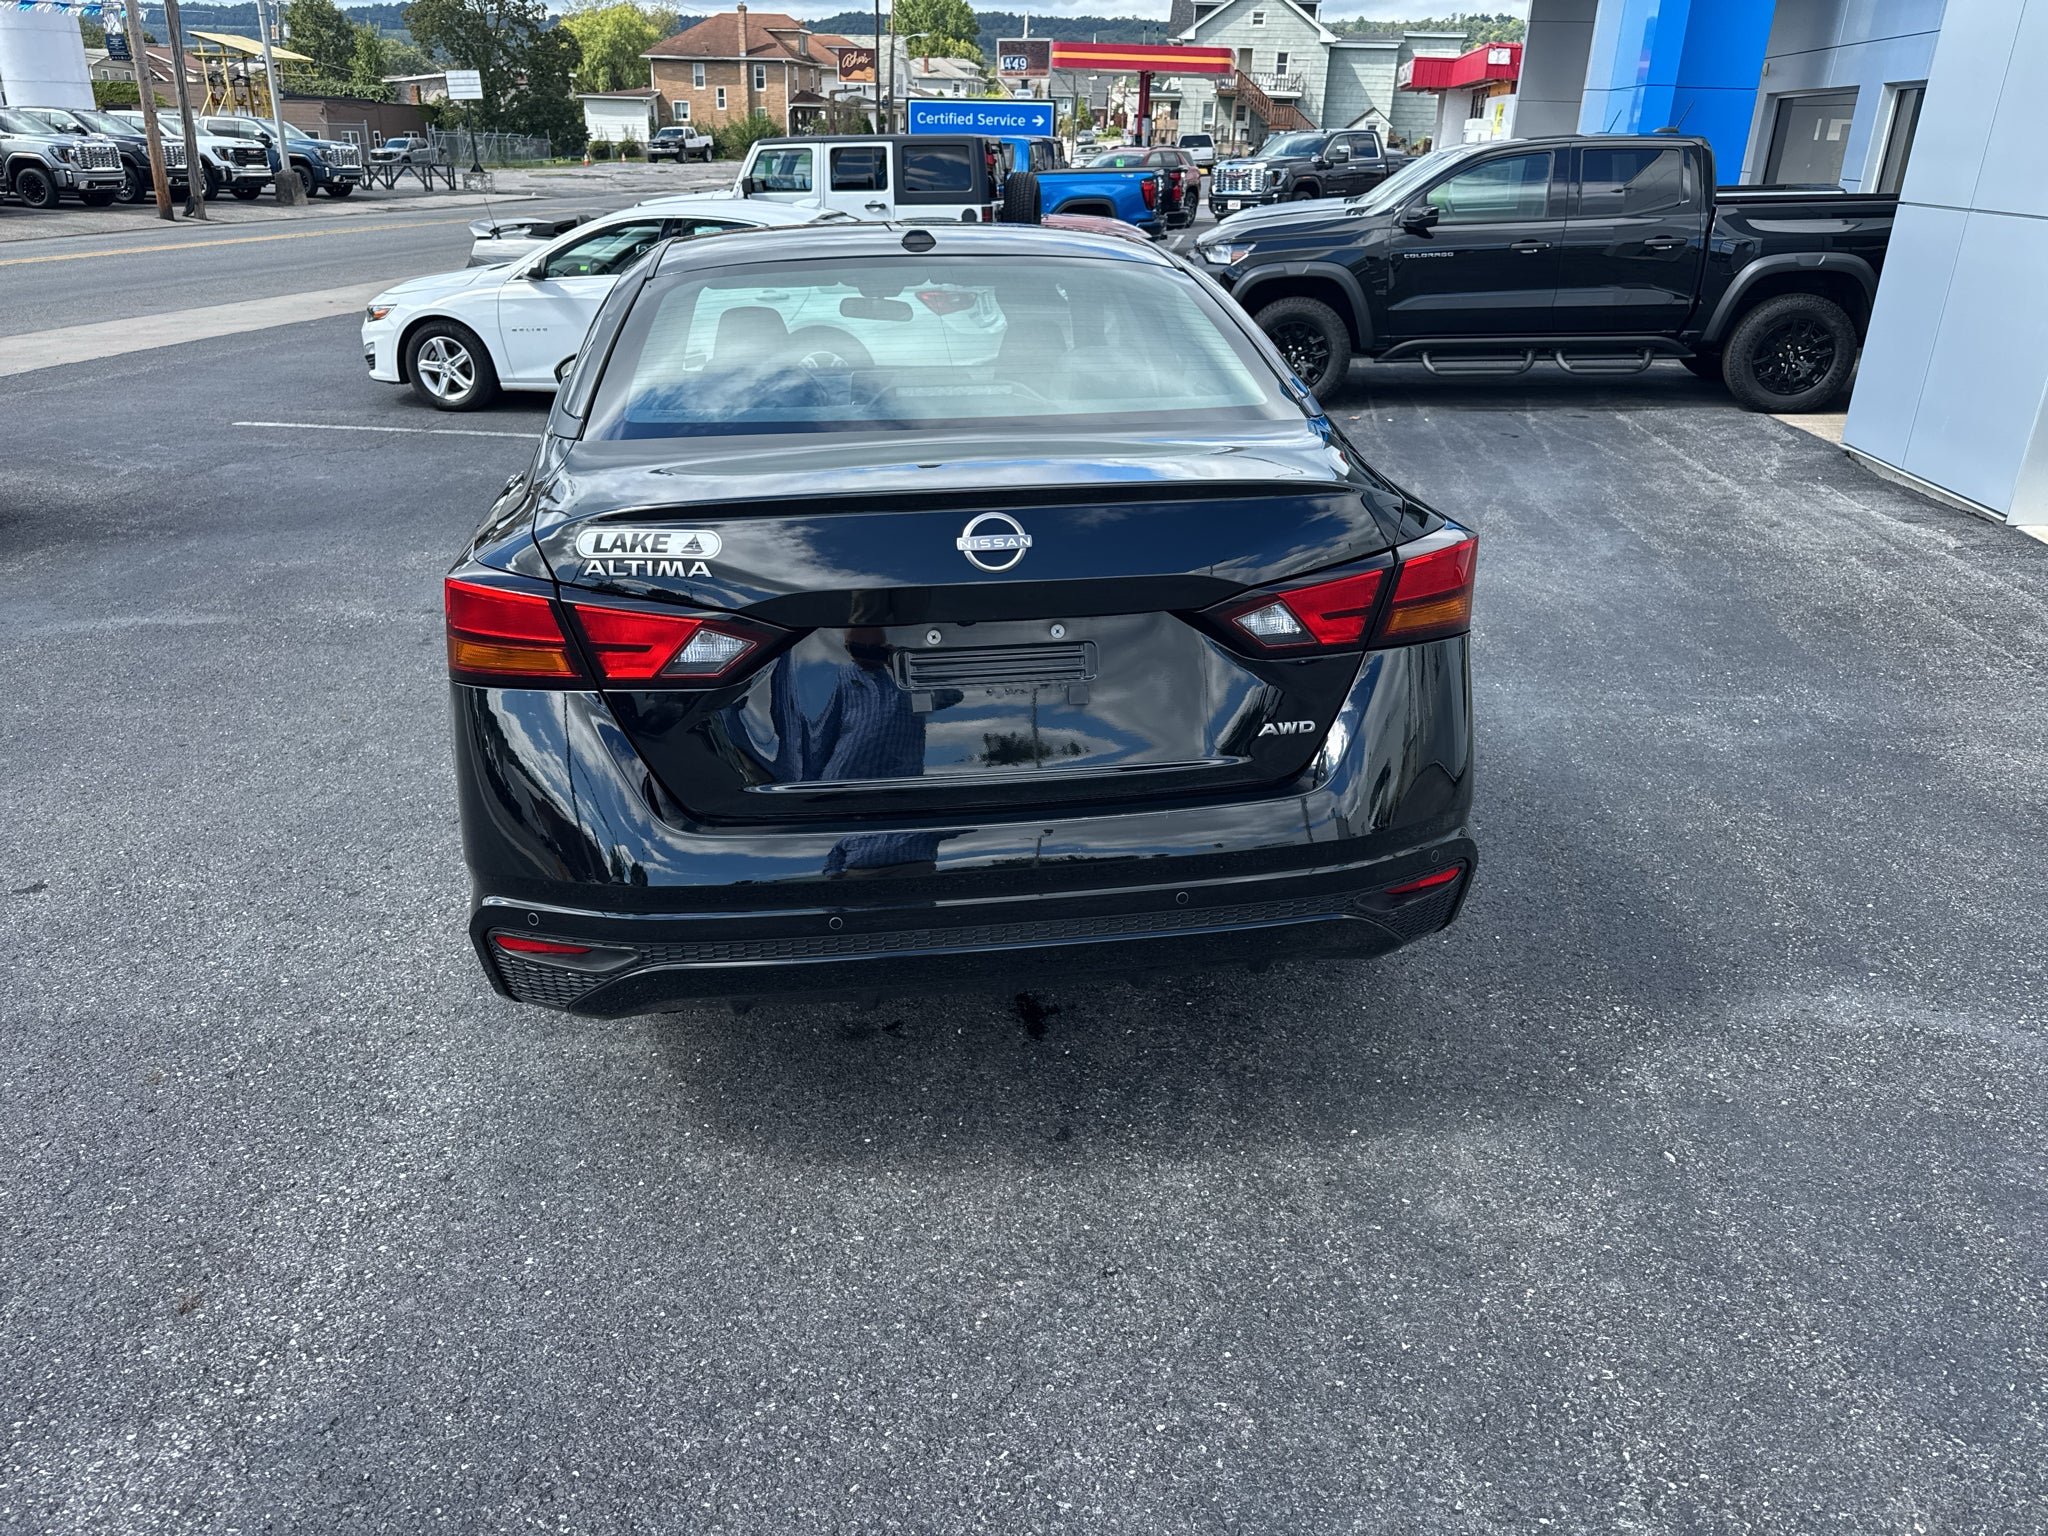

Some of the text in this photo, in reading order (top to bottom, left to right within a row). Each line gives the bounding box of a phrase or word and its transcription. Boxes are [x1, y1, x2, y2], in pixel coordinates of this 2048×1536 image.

[917, 112, 1026, 126] Certified Service
[592, 533, 672, 553] LAKE
[959, 536, 1031, 549] NISSAN
[584, 555, 713, 577] ALTIMA
[1258, 720, 1316, 737] AWD
